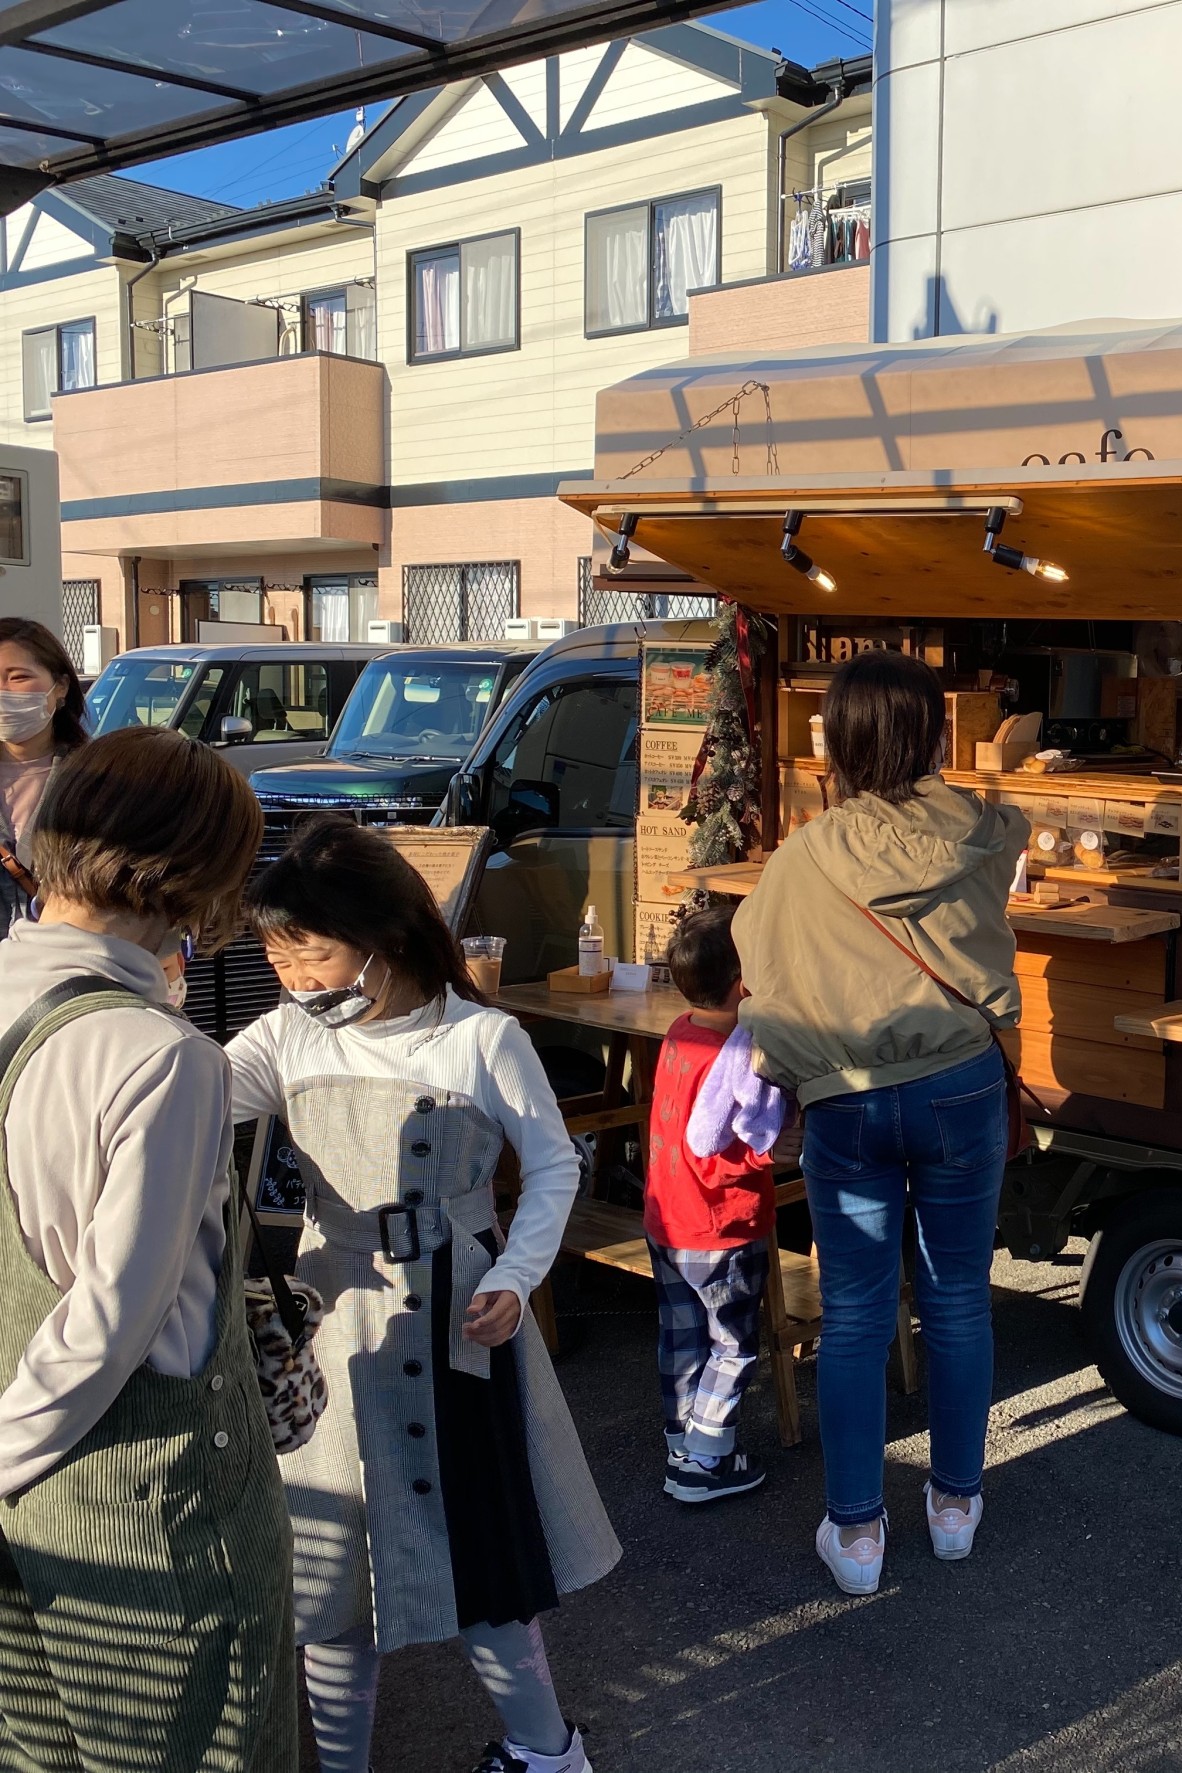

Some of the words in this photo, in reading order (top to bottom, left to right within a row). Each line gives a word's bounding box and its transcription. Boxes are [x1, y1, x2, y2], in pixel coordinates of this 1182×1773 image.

[645, 741, 678, 750] COFFEE
[640, 826, 658, 835] HOT
[662, 827, 687, 836] SAND
[734, 1454, 748, 1471] N
